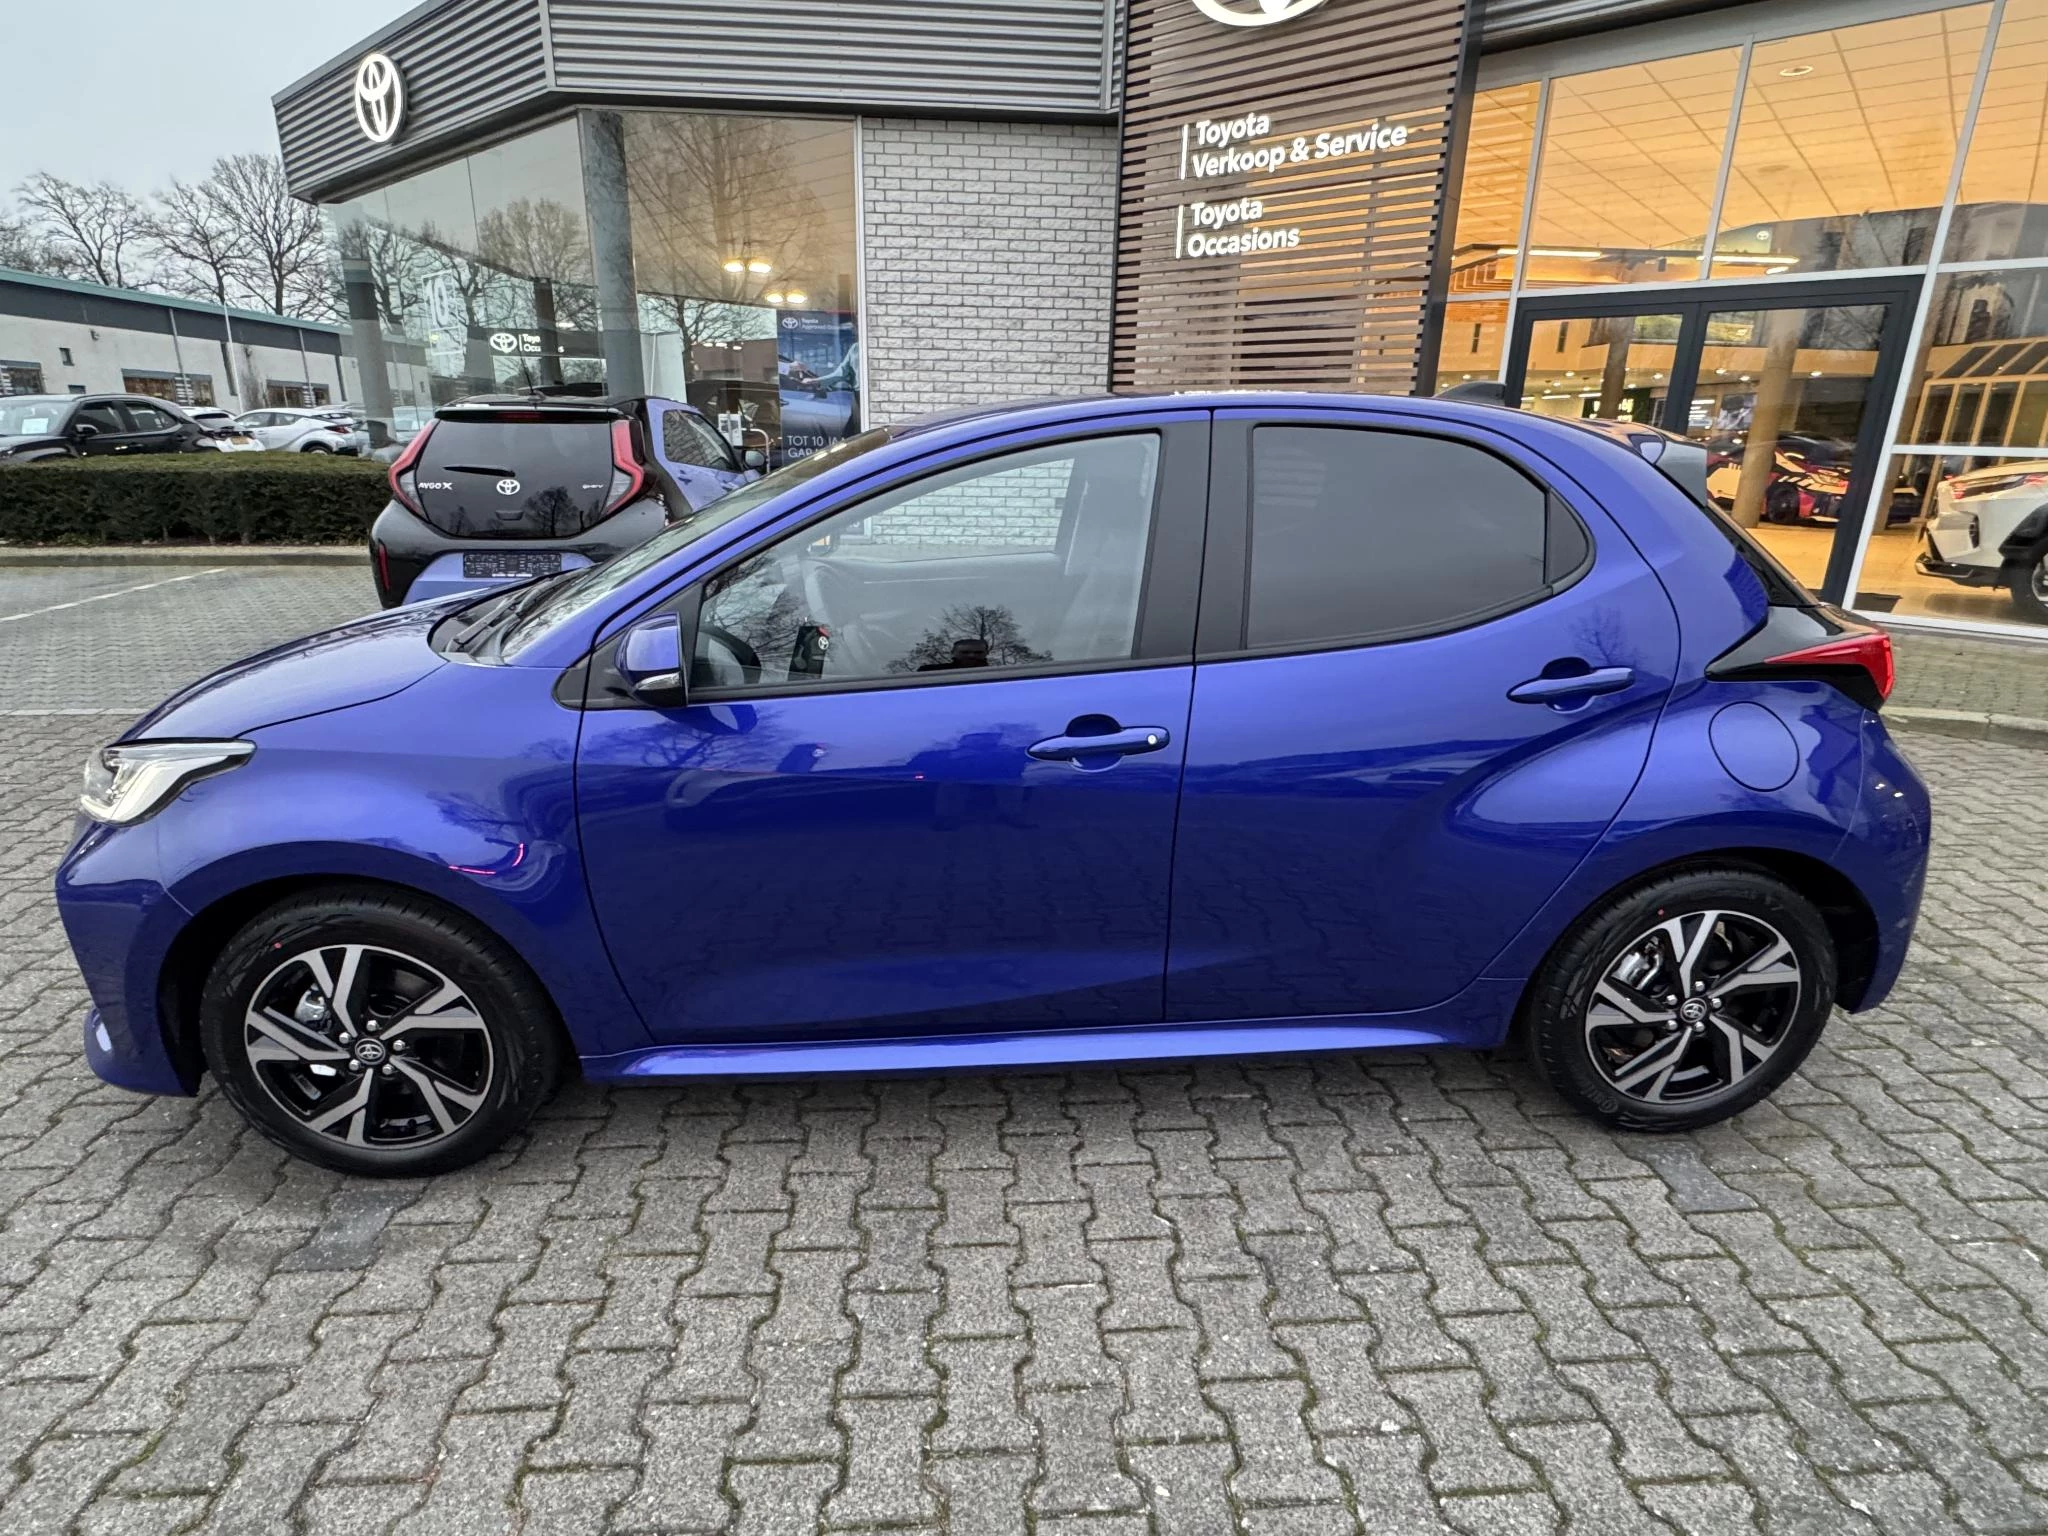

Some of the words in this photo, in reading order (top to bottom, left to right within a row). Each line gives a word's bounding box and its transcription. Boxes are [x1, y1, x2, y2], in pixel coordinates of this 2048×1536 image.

[1195, 112, 1270, 148] Toyota
[1192, 147, 1286, 177] Verkoop
[1290, 136, 1310, 163] &
[1314, 124, 1408, 159] Service
[1190, 197, 1264, 230] Toyota
[1187, 227, 1301, 258] Occasions
[787, 435, 808, 446] TOT
[811, 435, 824, 447] 10
[418, 482, 442, 490] AYGO
[442, 481, 453, 491] X
